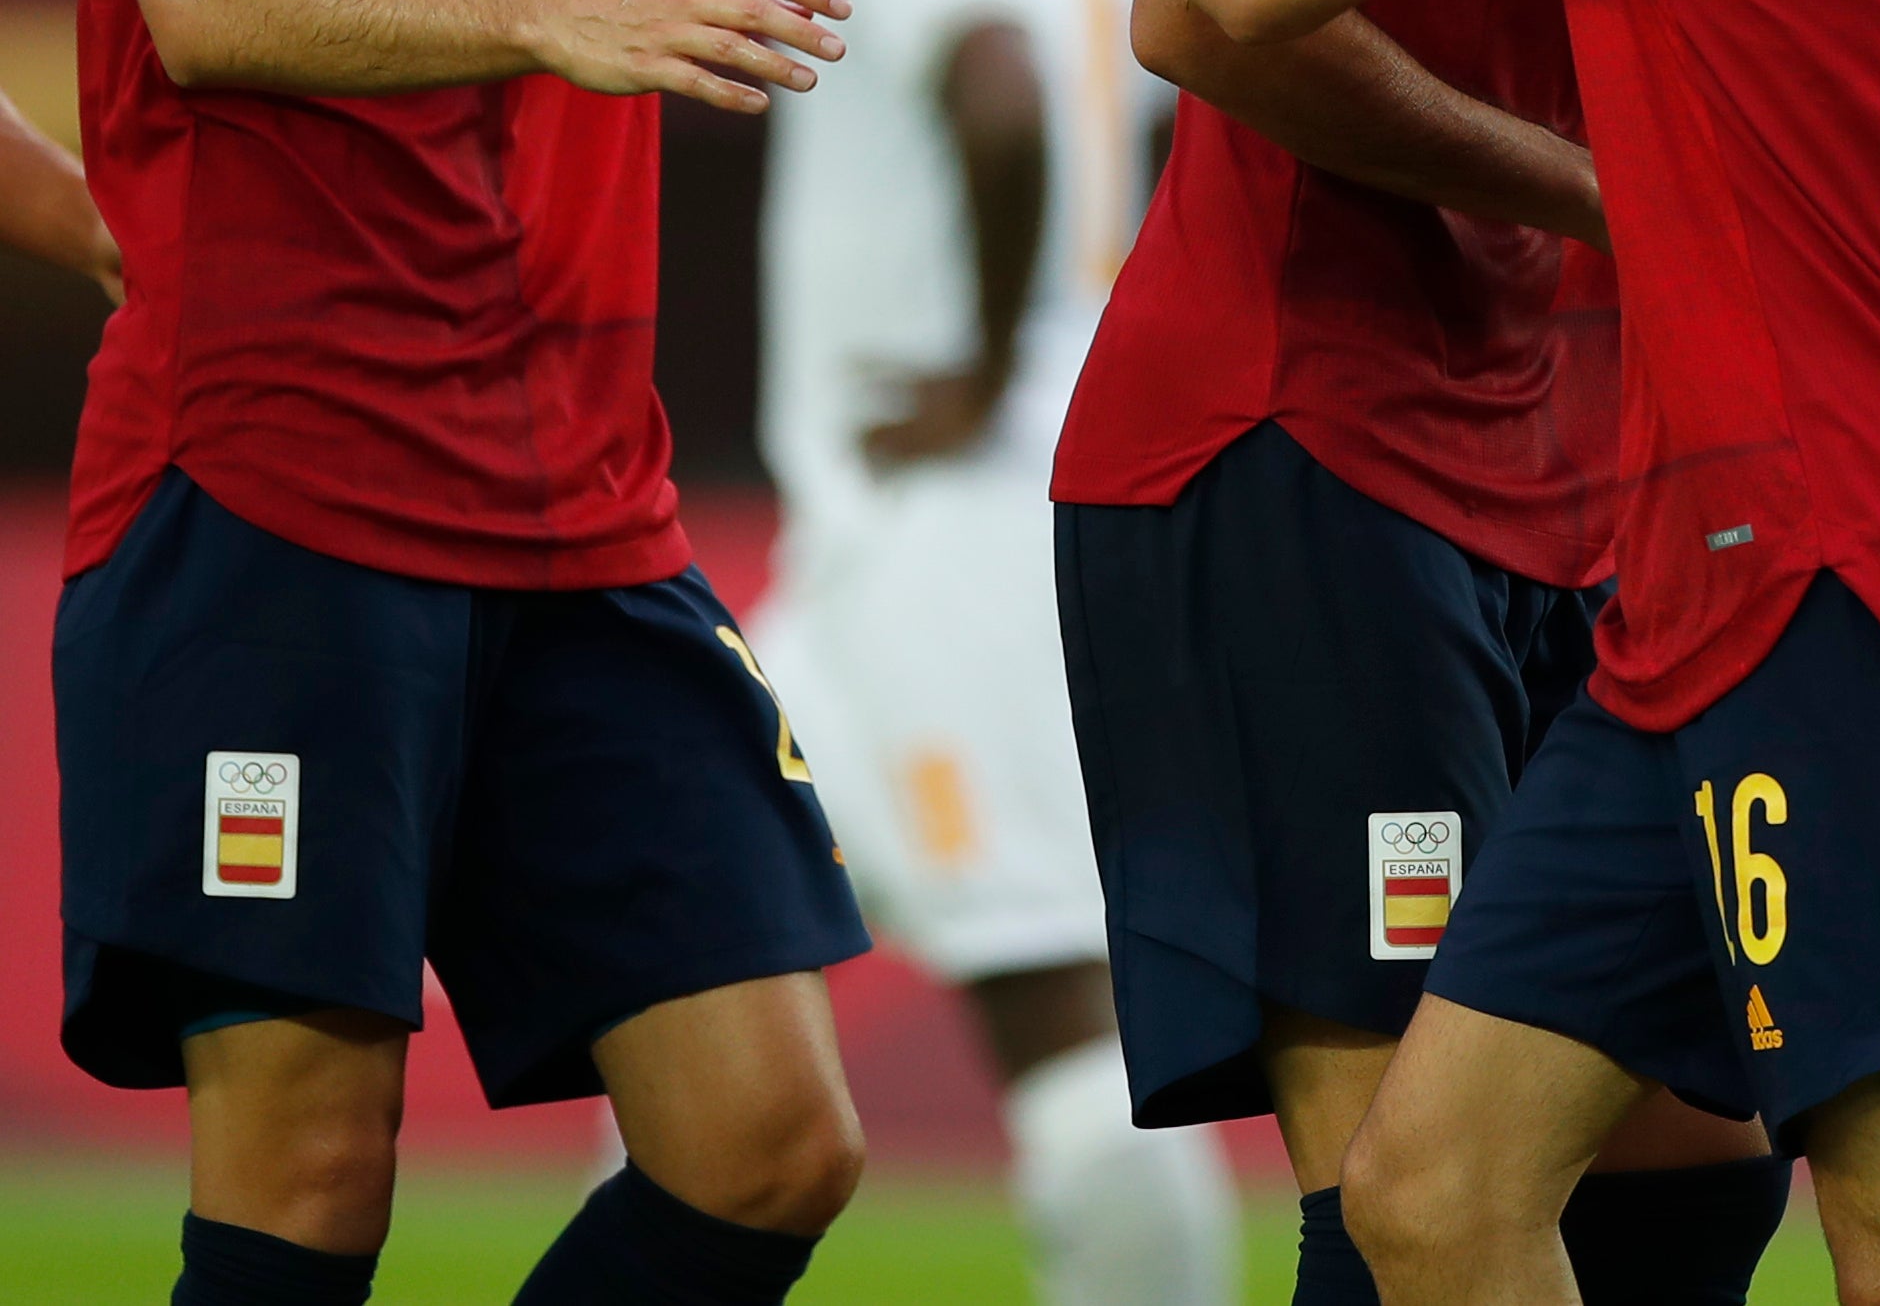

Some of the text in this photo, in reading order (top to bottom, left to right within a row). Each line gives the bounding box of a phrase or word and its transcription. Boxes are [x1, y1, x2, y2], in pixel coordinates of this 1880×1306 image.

[224, 801, 279, 815] ESPAÑA
[1389, 862, 1444, 875] ESPAÑA
[1694, 772, 1788, 966] 16
